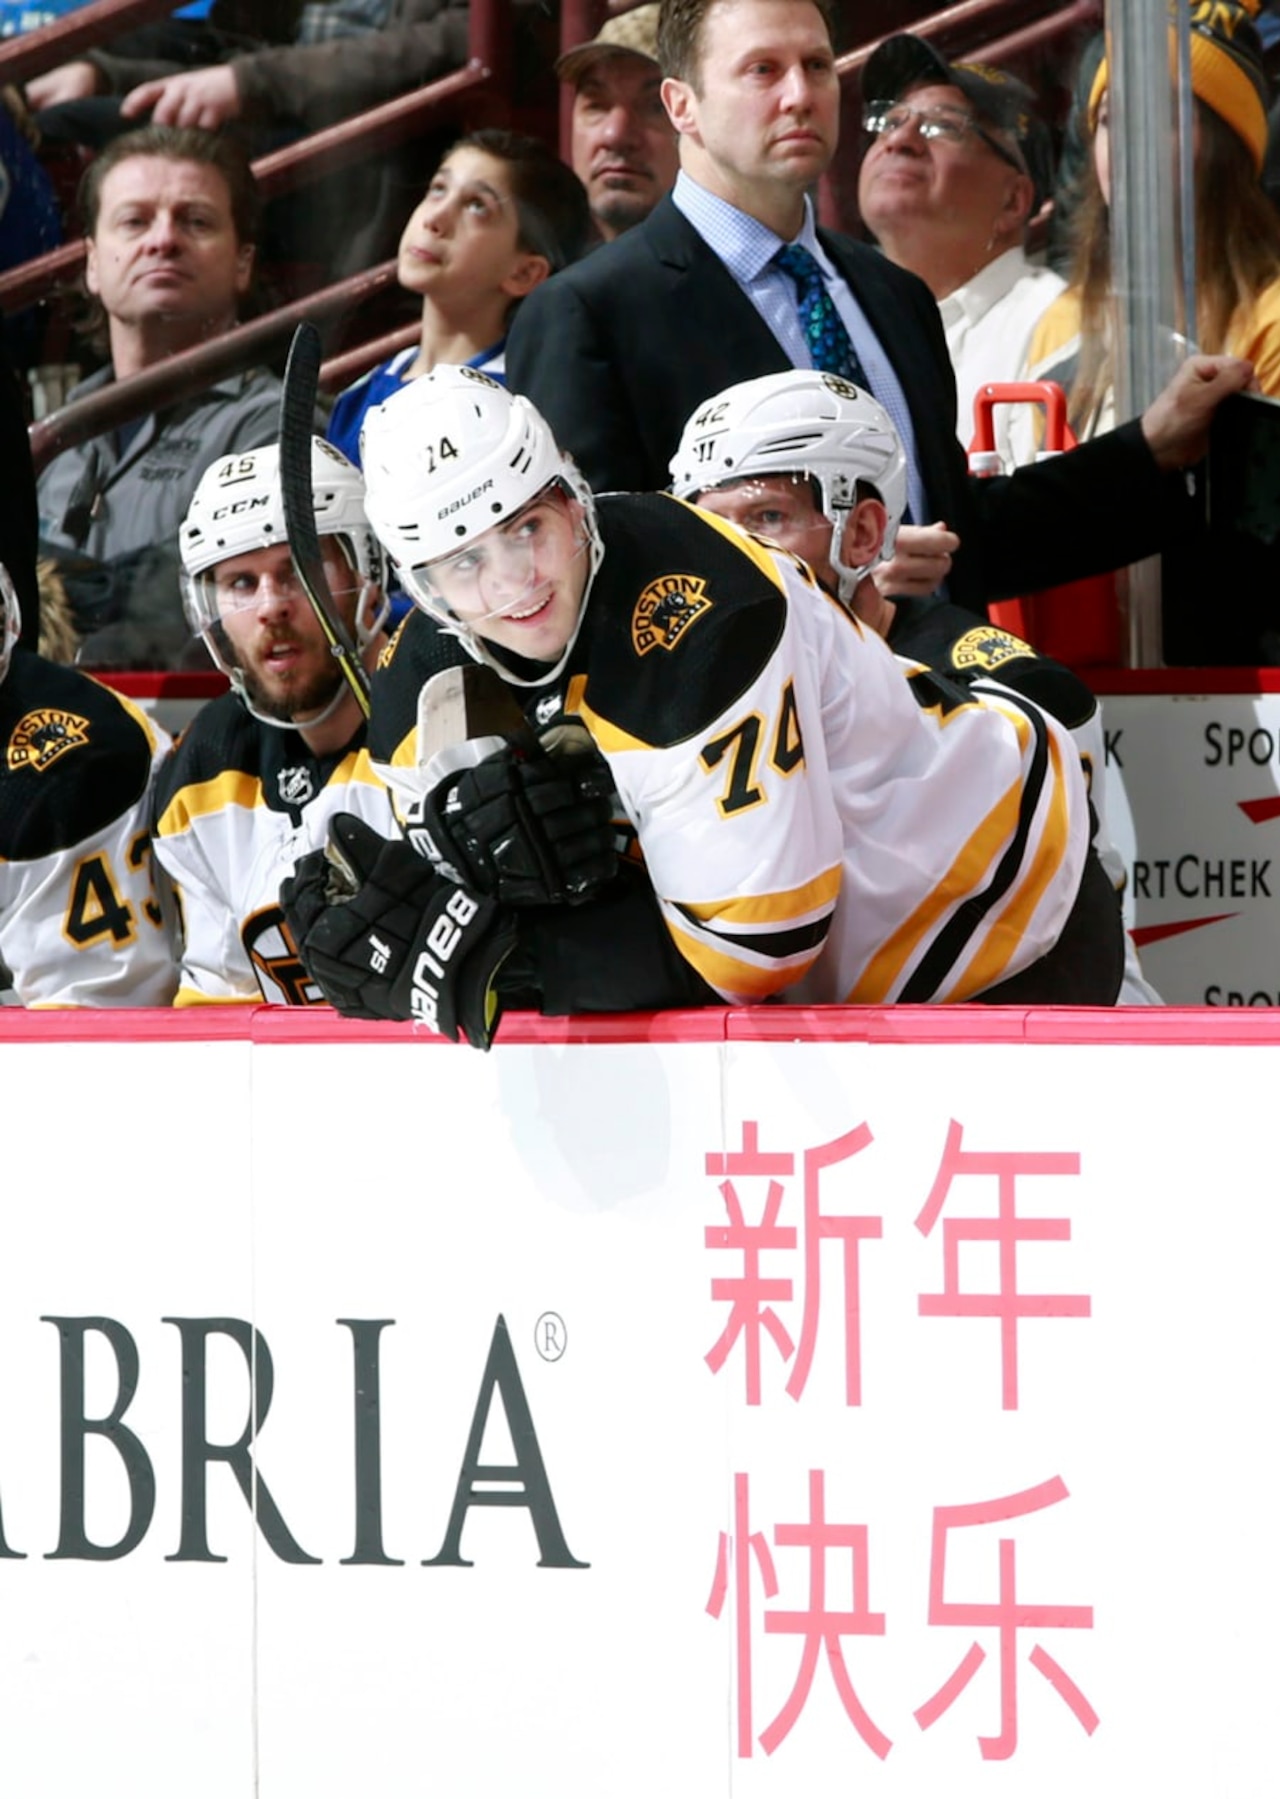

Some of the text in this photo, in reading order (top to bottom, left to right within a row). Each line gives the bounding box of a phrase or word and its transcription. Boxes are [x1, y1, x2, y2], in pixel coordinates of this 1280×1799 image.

[694, 402, 730, 428] 42
[218, 456, 256, 478] 45
[212, 495, 270, 521] CCM
[634, 576, 702, 653] BOSTON
[11, 711, 84, 767] BOSTON
[703, 1117, 1092, 1411] 新年
[703, 1468, 1101, 1762] 快乐
